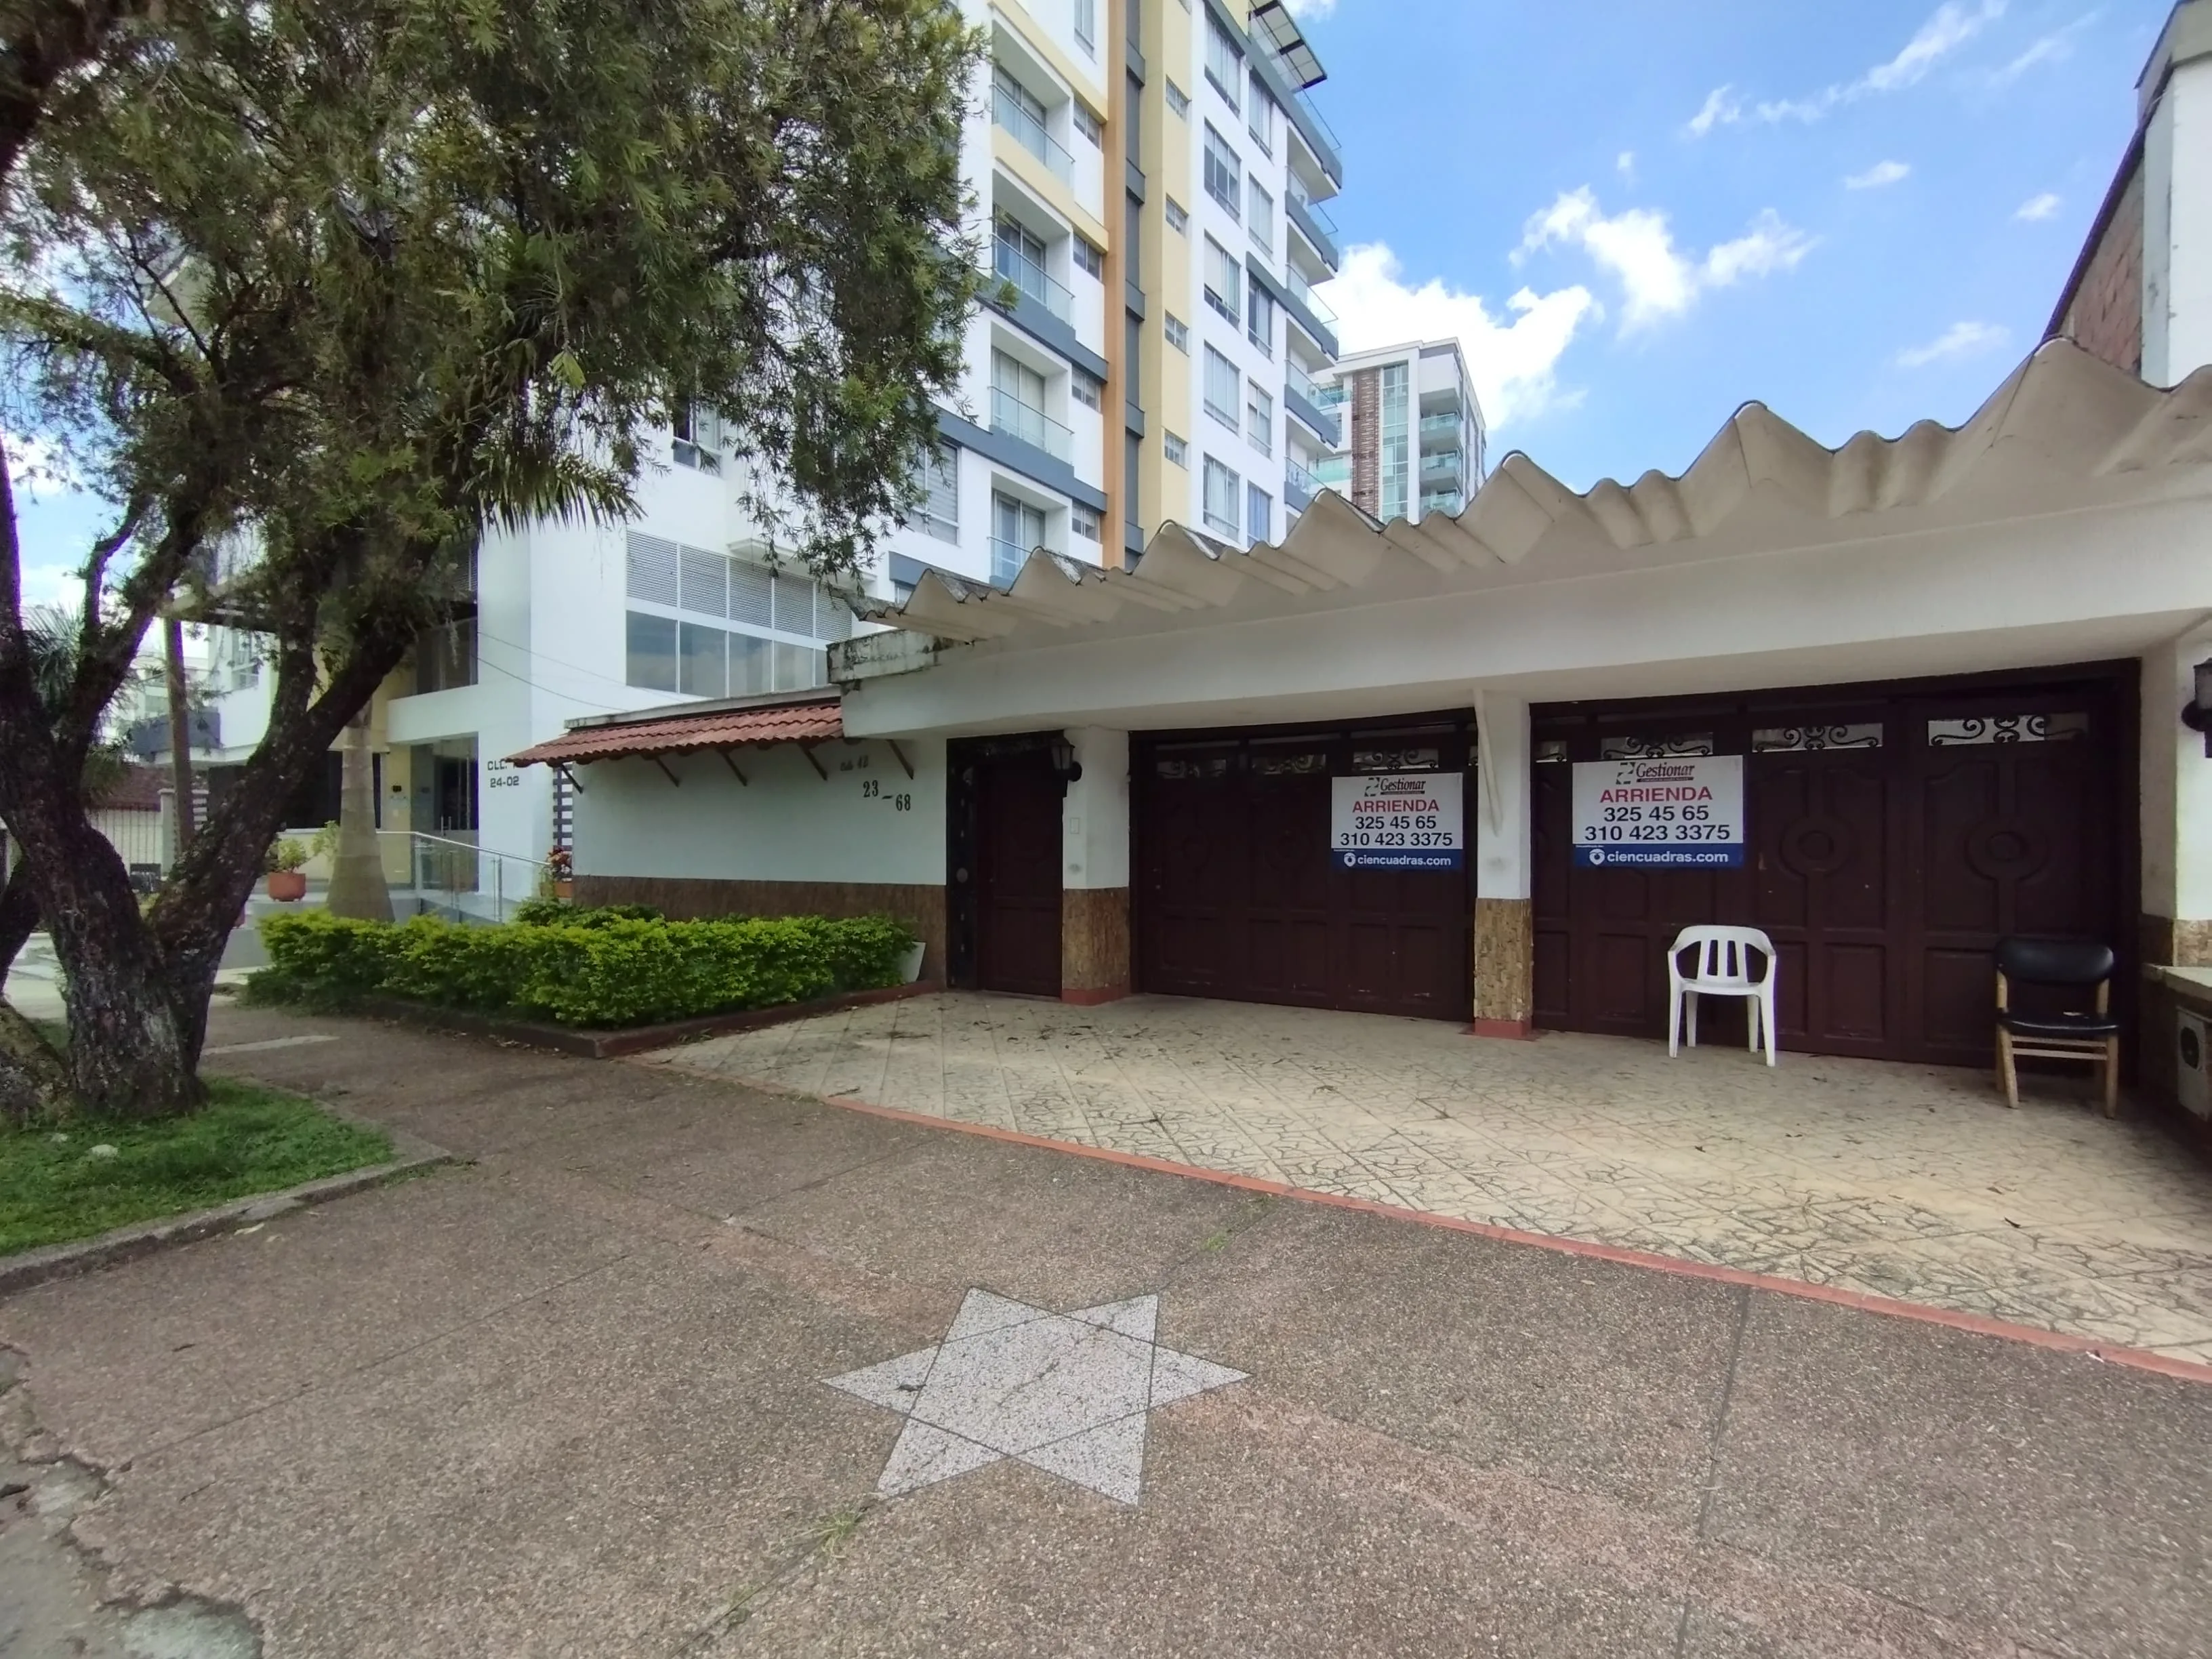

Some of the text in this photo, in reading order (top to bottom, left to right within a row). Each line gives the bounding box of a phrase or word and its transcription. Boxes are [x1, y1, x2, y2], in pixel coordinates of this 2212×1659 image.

[1636, 762, 1696, 778] Gestionar
[490, 775, 519, 787] 24-02
[1380, 777, 1426, 791] Gestionar
[1599, 786, 1713, 803] ARRIENDA
[1352, 799, 1439, 813] ARRIENDA
[1603, 805, 1709, 822] 325 45 65
[1355, 815, 1437, 829] 325 45 65
[1340, 832, 1452, 846] 310 423 3375
[1584, 825, 1730, 841] 310 423 3375
[1357, 855, 1451, 866] ciencuadras.com
[1607, 851, 1728, 863] ciencuadras.com
